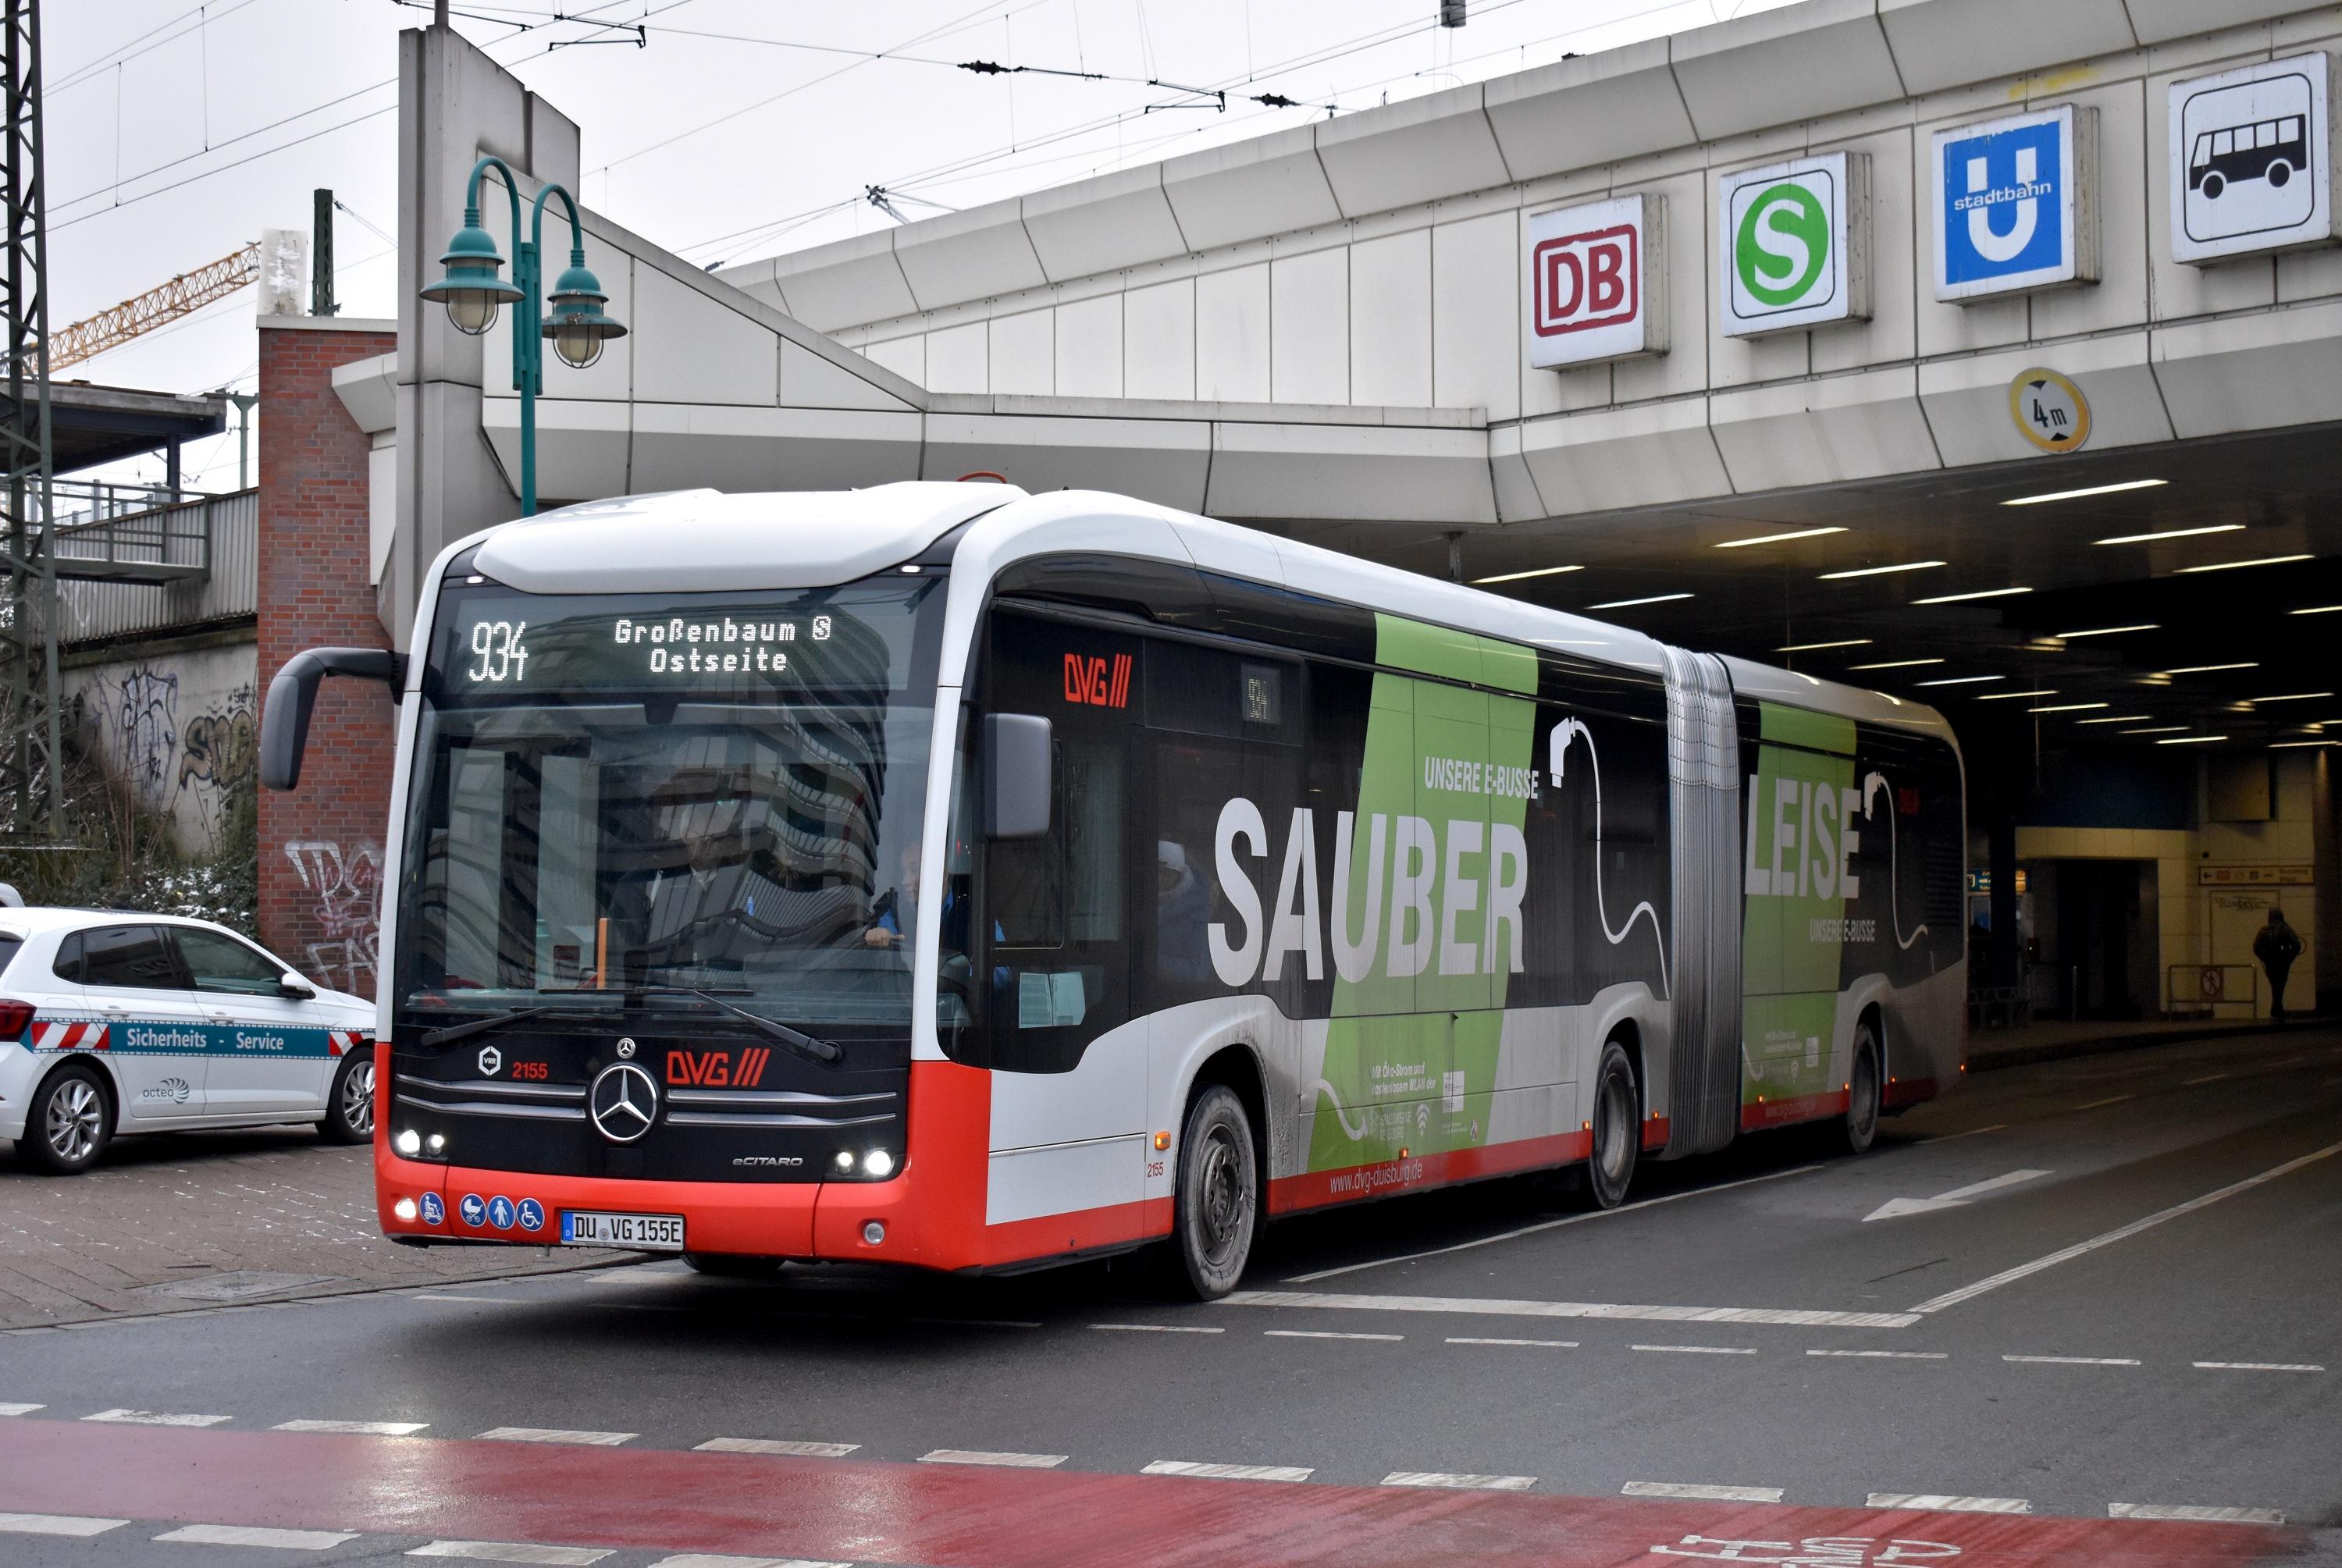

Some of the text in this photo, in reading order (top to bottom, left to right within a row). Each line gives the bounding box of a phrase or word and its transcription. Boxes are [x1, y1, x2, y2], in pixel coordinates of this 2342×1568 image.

[1954, 182, 2052, 211] stadtbahn
[1754, 199, 1810, 291] S
[1547, 243, 1625, 321] DB
[468, 622, 529, 681] 934
[614, 617, 795, 644] Großenbaum
[650, 647, 787, 673] Ostseite
[1424, 756, 1539, 800] UNSERE E-BUSSE
[1745, 773, 1861, 901] LEISE
[1207, 797, 1529, 987] SAUBER
[1810, 918, 1876, 942] UNSERE E-BUSSE
[126, 1028, 207, 1048] Sicherheits
[236, 1031, 284, 1051] Service
[511, 1061, 548, 1079] 2155
[1383, 1061, 1412, 1078] Öko-Strom
[1414, 1061, 1425, 1075] und
[143, 1088, 174, 1097] octeo
[1426, 1076, 1436, 1090] der
[732, 1157, 803, 1166] eCITARO
[1147, 1161, 1164, 1179] 2155
[1329, 1161, 1423, 1194] www.dvg-duisburg.de
[575, 1216, 682, 1243] DU VG 155E
